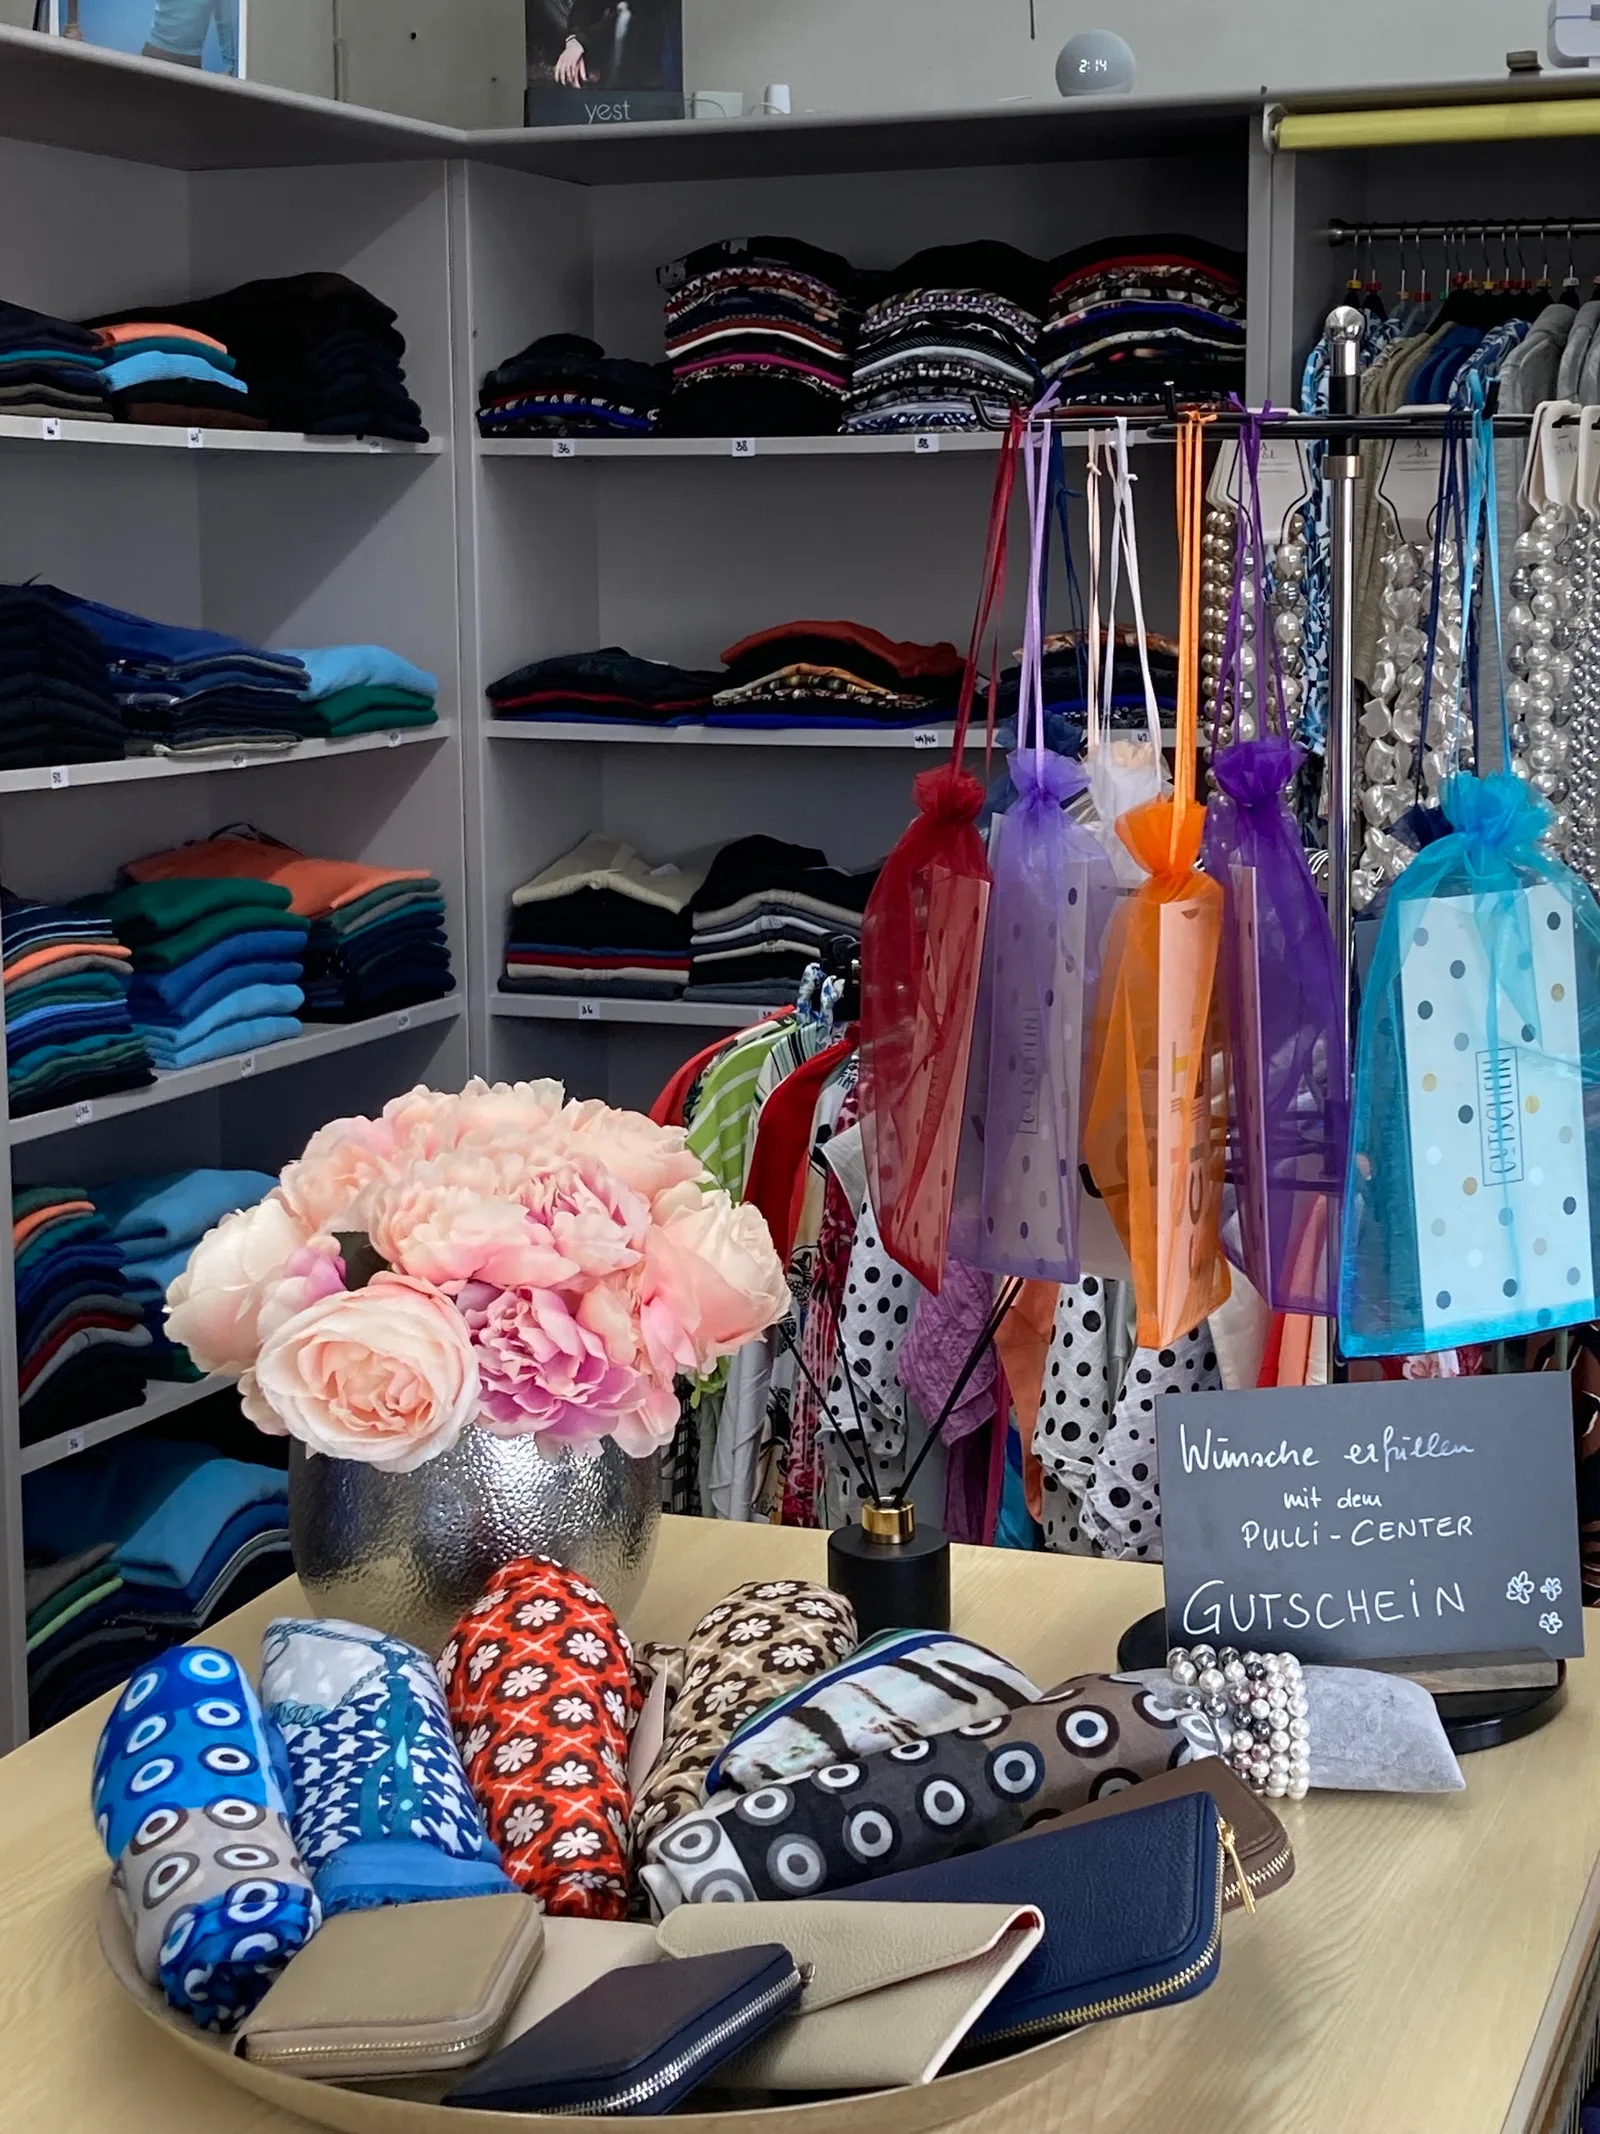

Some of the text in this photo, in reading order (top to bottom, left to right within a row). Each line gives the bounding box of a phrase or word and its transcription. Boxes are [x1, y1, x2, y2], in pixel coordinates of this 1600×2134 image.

[1079, 59, 1108, 73] 2:14
[584, 99, 631, 124] yest
[1482, 1058, 1517, 1174] GUTSCHEIN
[1344, 1424, 1475, 1473] erfüllen
[1283, 1486, 1383, 1511] mit dem
